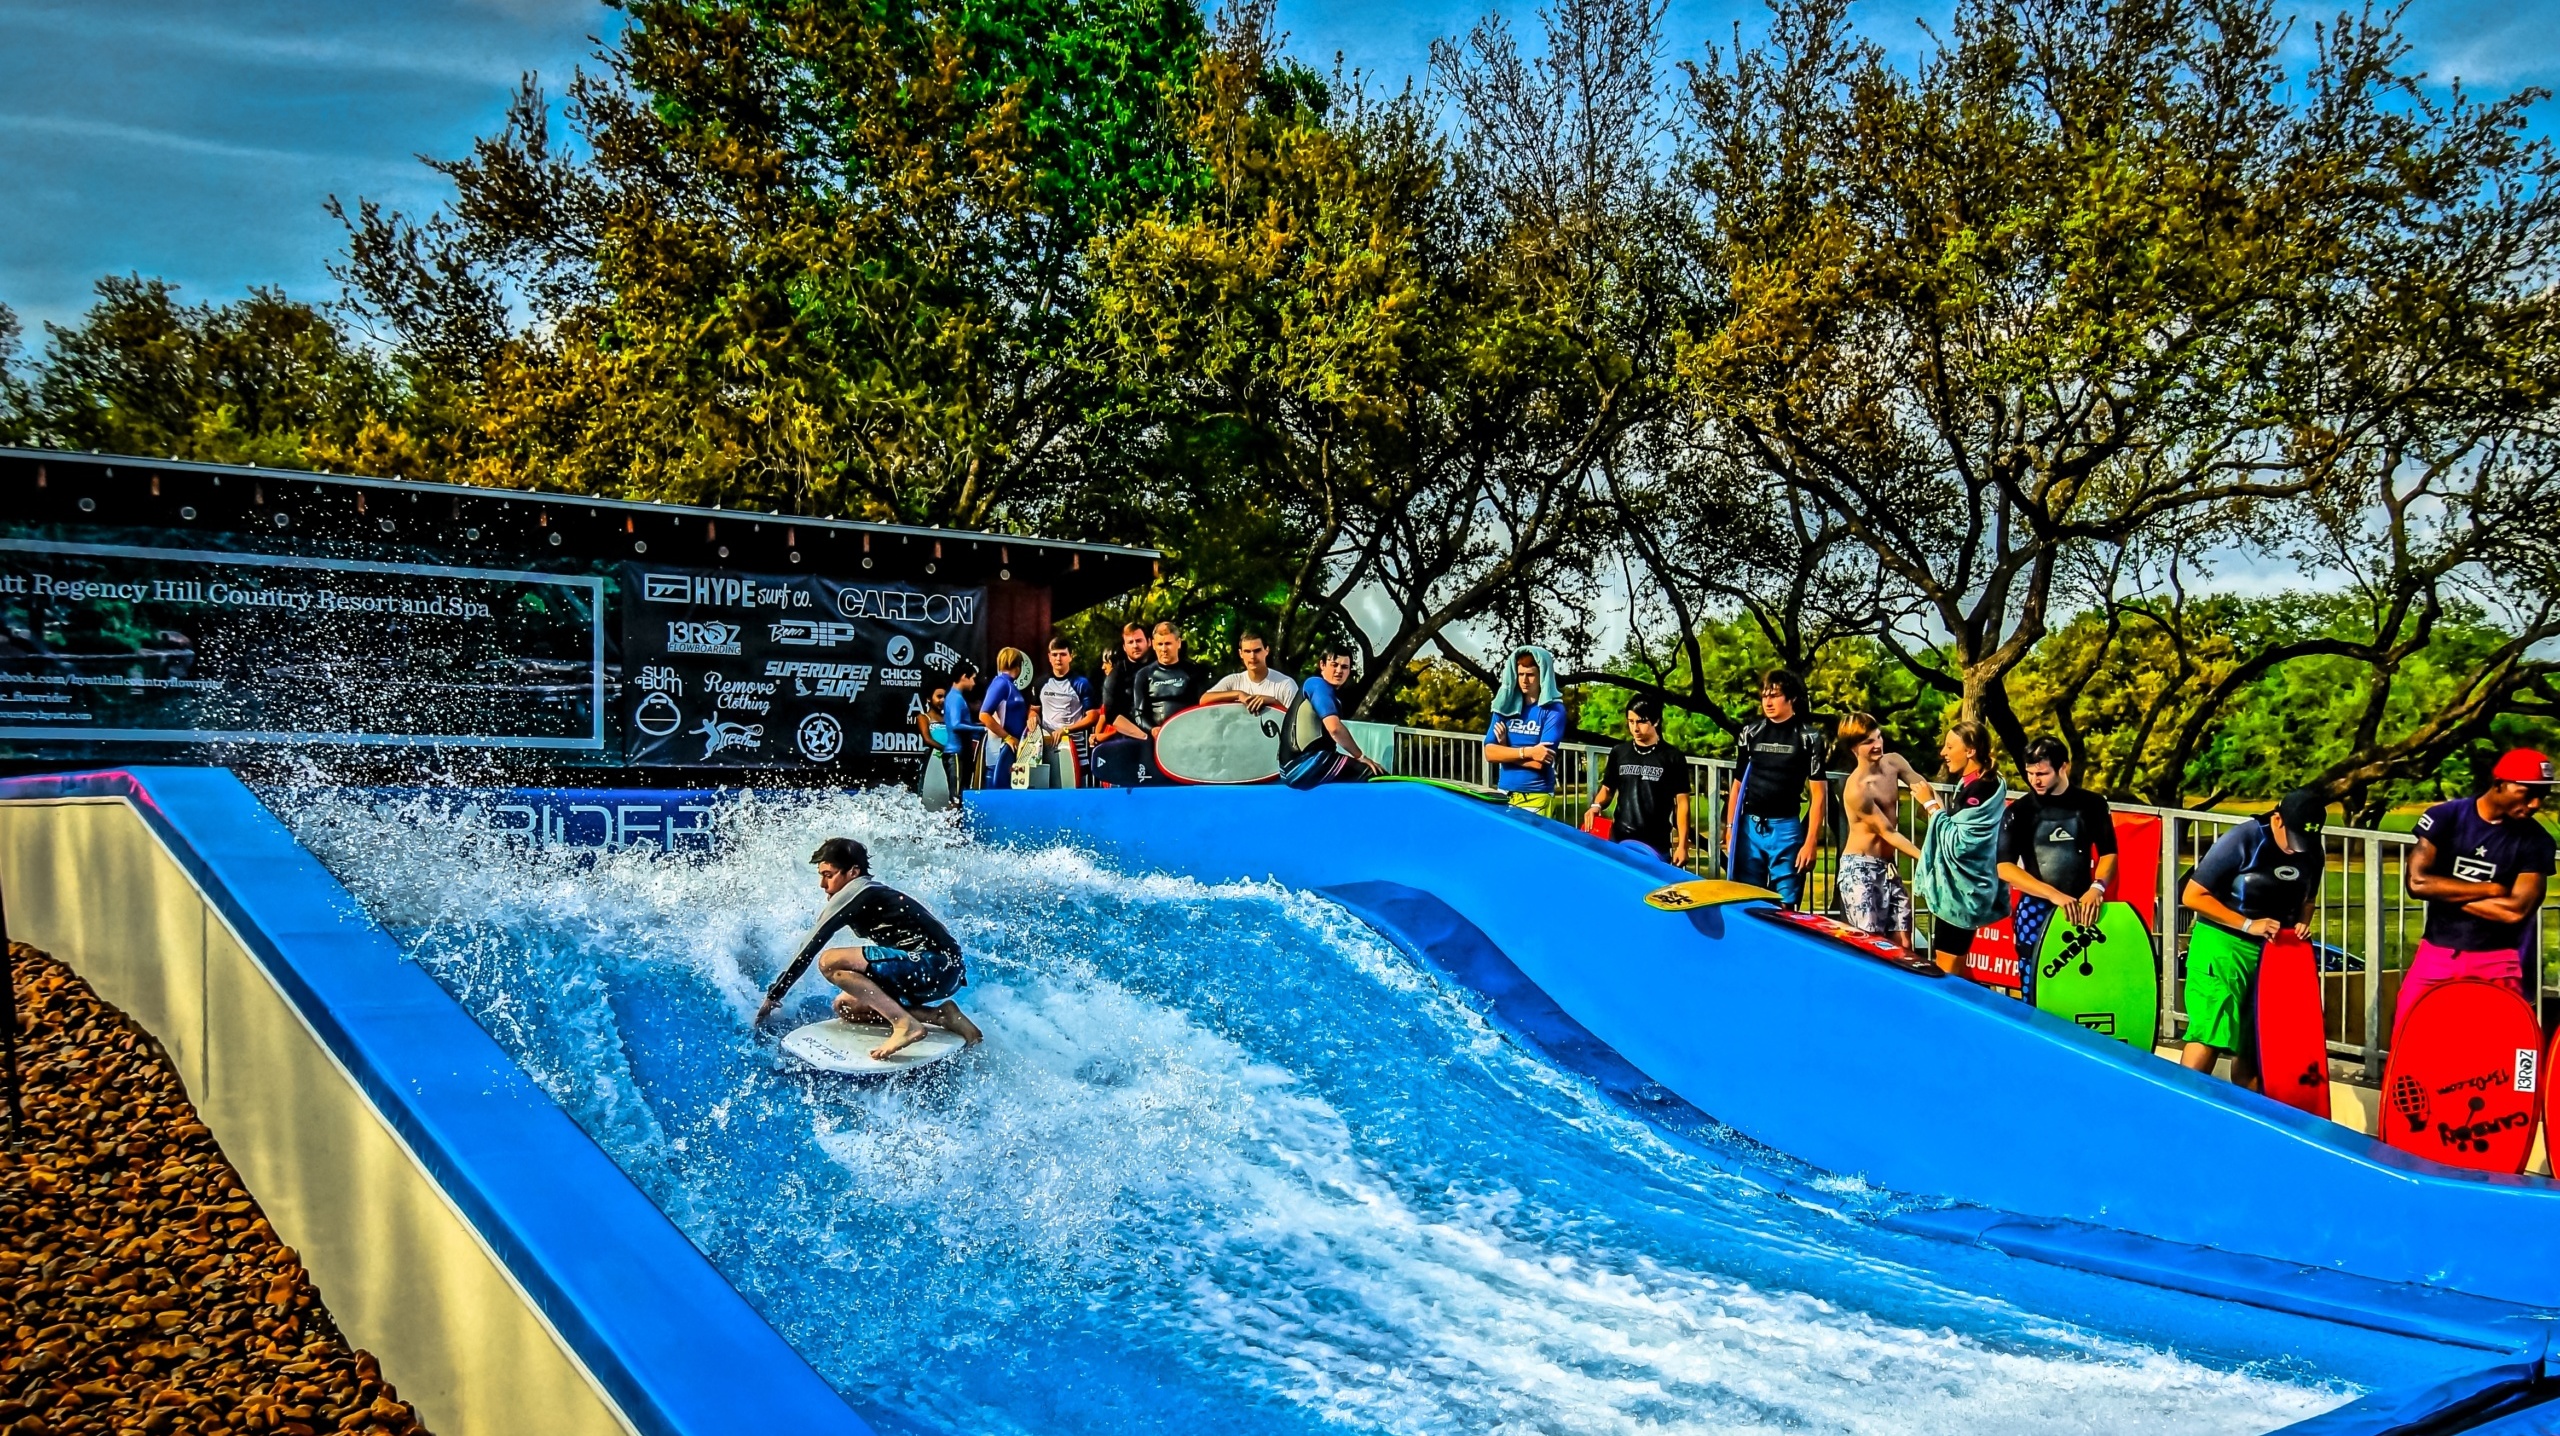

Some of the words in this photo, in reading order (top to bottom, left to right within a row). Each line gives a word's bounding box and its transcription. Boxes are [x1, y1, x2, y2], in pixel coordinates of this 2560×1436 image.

[32, 573, 149, 603] Regency
[153, 580, 201, 602] Hill
[208, 583, 312, 611] Country
[316, 589, 397, 612] Resort
[402, 596, 448, 615] and
[449, 597, 491, 621] Spa
[695, 577, 756, 607] HYPE
[757, 583, 791, 609] surf
[793, 590, 813, 607] co.
[837, 587, 974, 625] CARBON
[780, 619, 855, 647] DIP
[667, 643, 742, 655] FLOWBOARDING
[704, 670, 777, 694] Remove
[764, 661, 873, 680] SUPERDUPER
[880, 668, 922, 680] CHICKS
[815, 679, 868, 703] SURF
[903, 679, 922, 687] SHIRT
[717, 693, 771, 716] Clothing
[1618, 764, 1642, 776] WORLD
